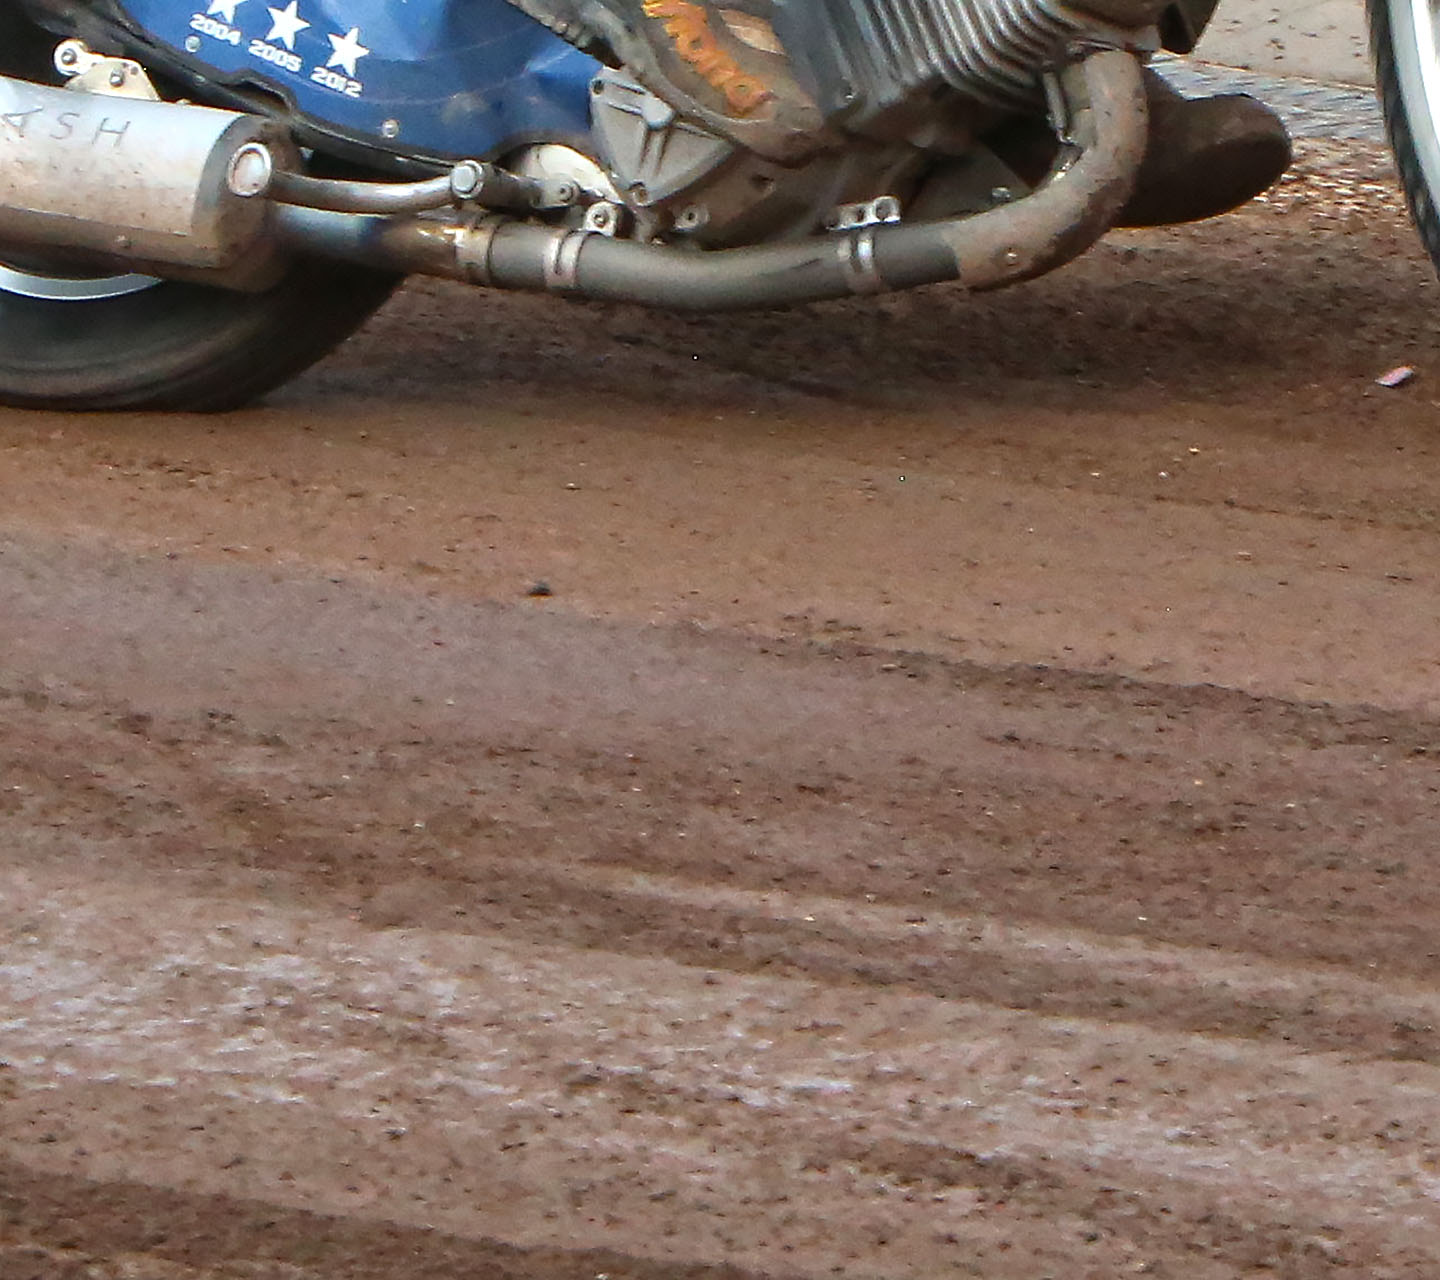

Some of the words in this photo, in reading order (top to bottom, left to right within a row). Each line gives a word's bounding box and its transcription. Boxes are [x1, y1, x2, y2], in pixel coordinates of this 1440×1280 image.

[189, 13, 243, 47] 2004
[248, 40, 303, 74] 2005
[310, 66, 364, 99] 2012
